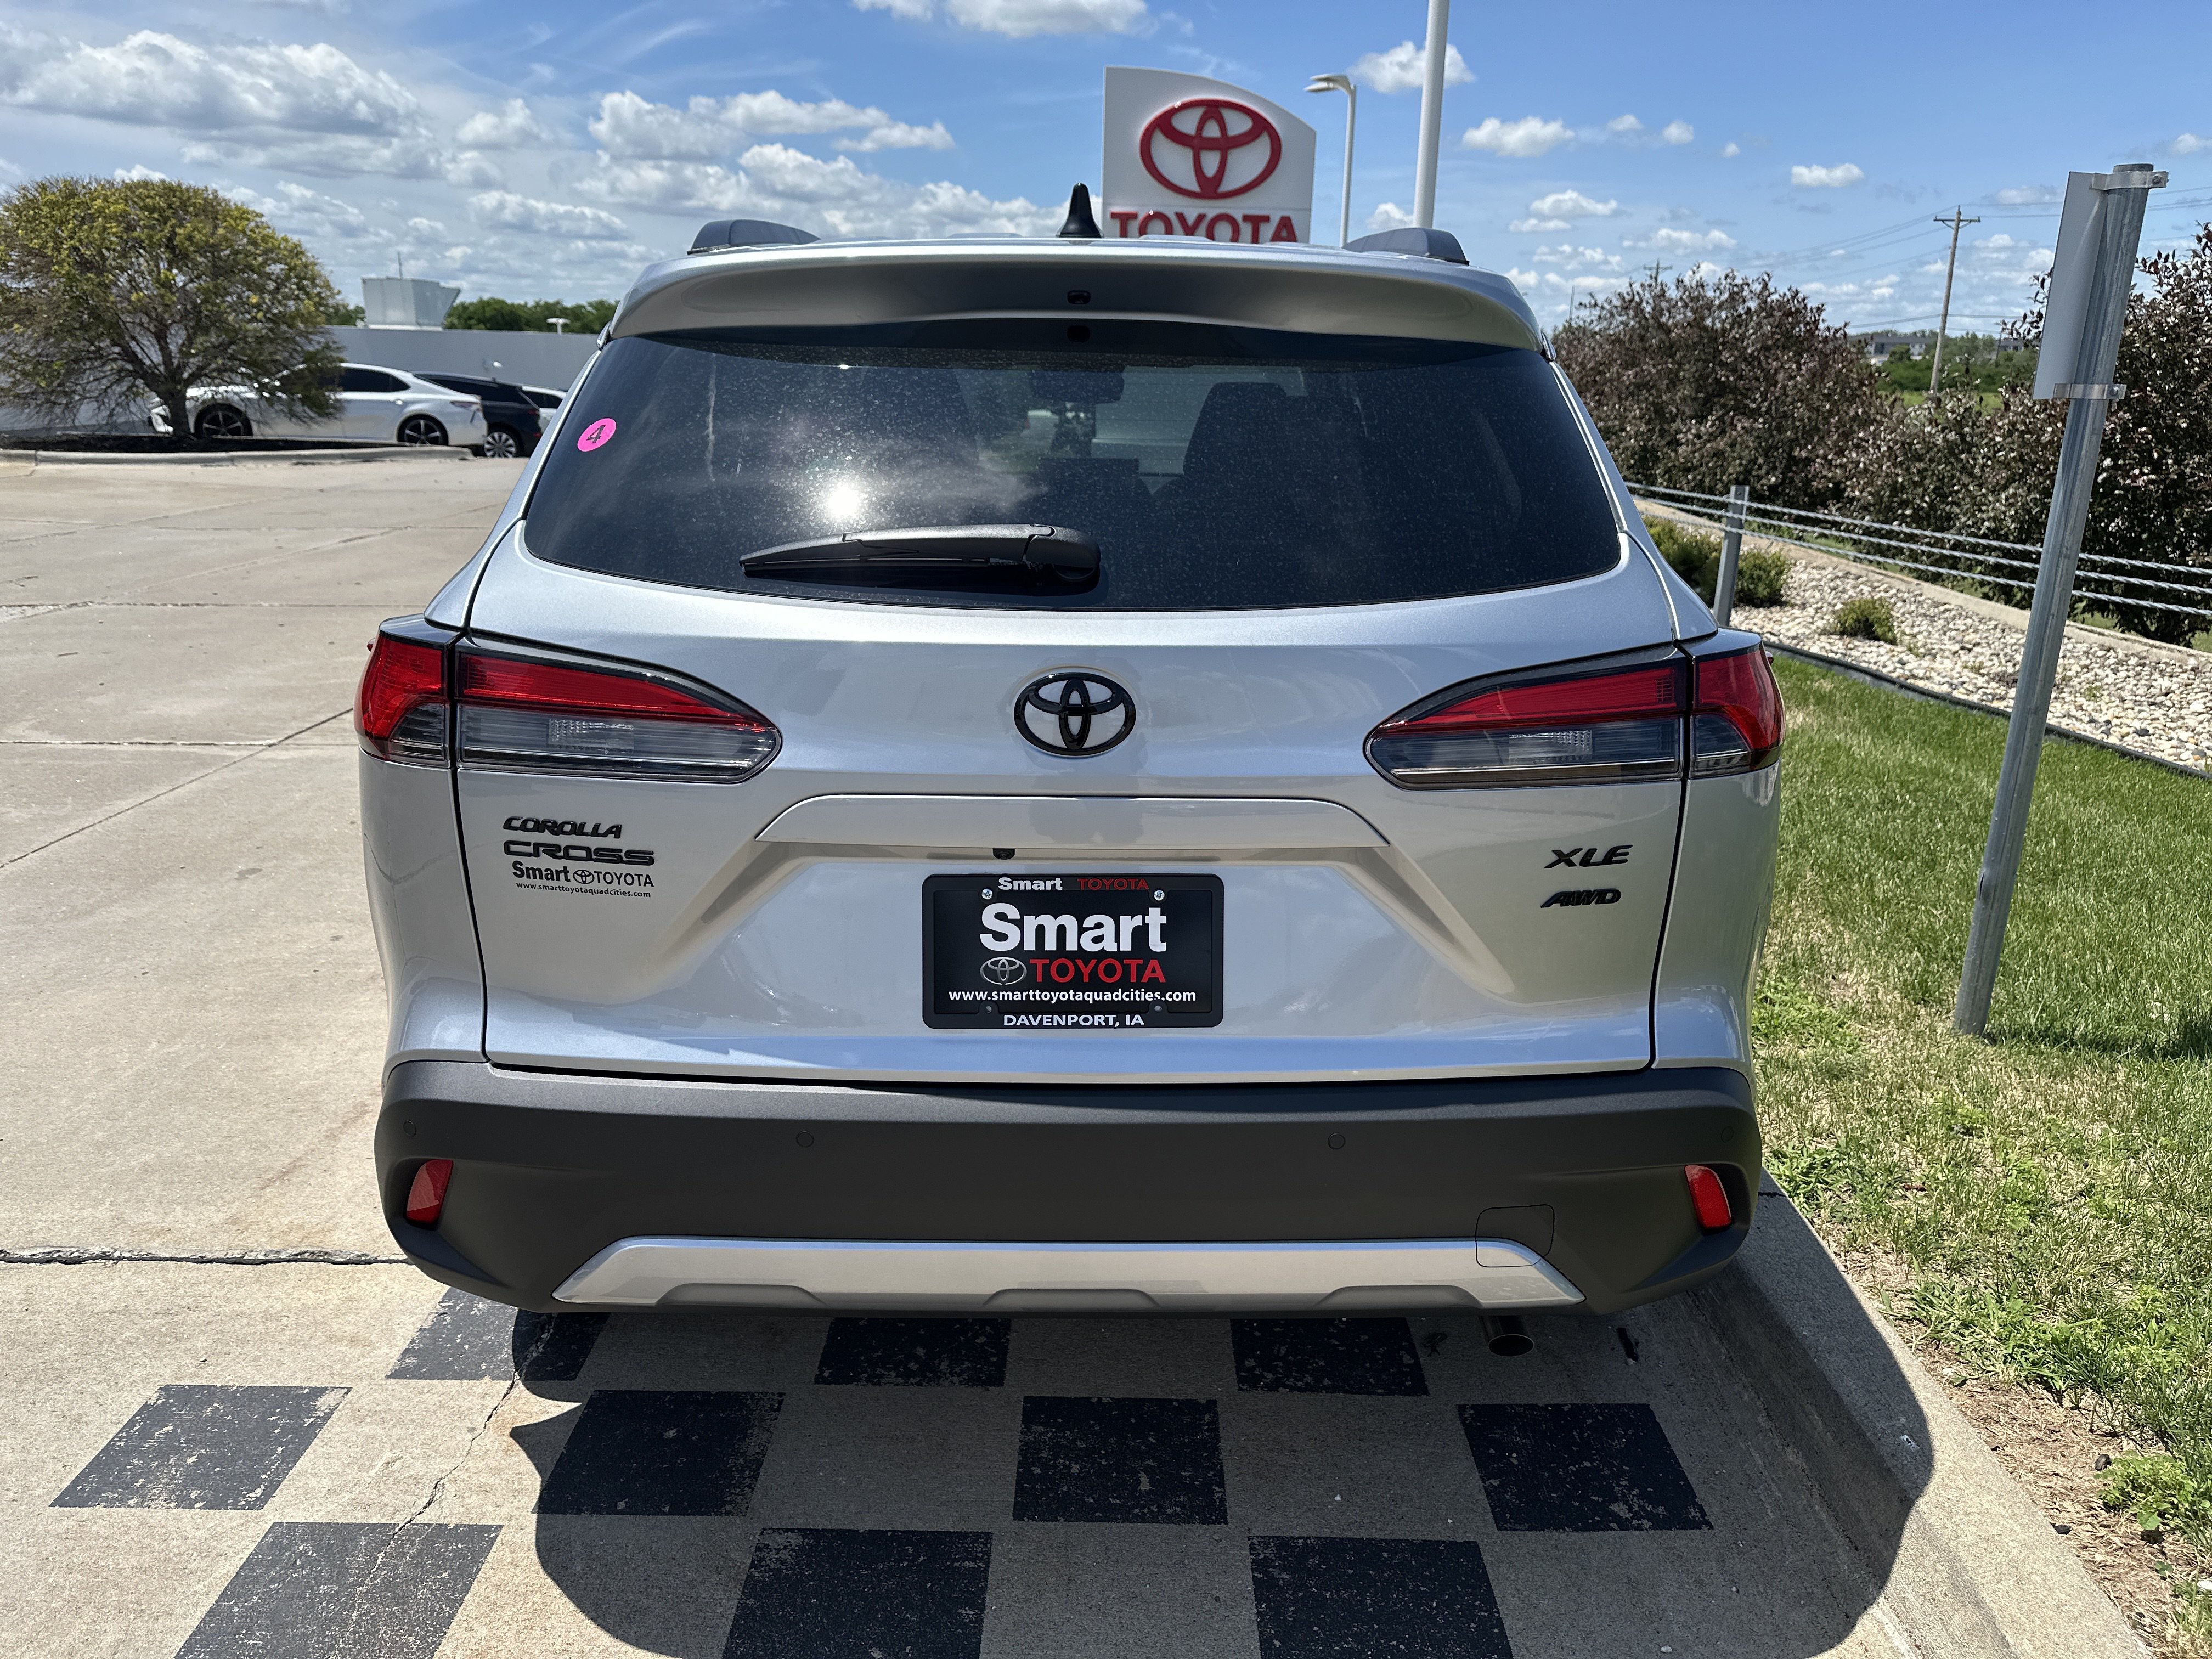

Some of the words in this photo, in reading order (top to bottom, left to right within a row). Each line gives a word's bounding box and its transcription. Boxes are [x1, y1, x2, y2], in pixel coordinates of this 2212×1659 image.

[1110, 211, 1298, 244] TOYOTA
[586, 425, 606, 444] 4
[503, 816, 623, 839] COROLLA
[503, 840, 654, 866] CROSS
[1544, 844, 1633, 868] XLE
[512, 860, 571, 882] Smart
[594, 870, 654, 887] TOYOTA
[998, 877, 1063, 891] Smart
[1077, 878, 1149, 891] TOYOTA
[516, 882, 651, 898] www.smarttoyotaquadcities.com
[1541, 888, 1622, 909] AWD
[979, 902, 1167, 952] Smart
[1029, 958, 1166, 983] TOYOTA
[948, 988, 1197, 1004] www.smarttoyotaquadcities.com
[1003, 1014, 1120, 1028] DAVENPORT,
[1125, 1014, 1144, 1026] IA
